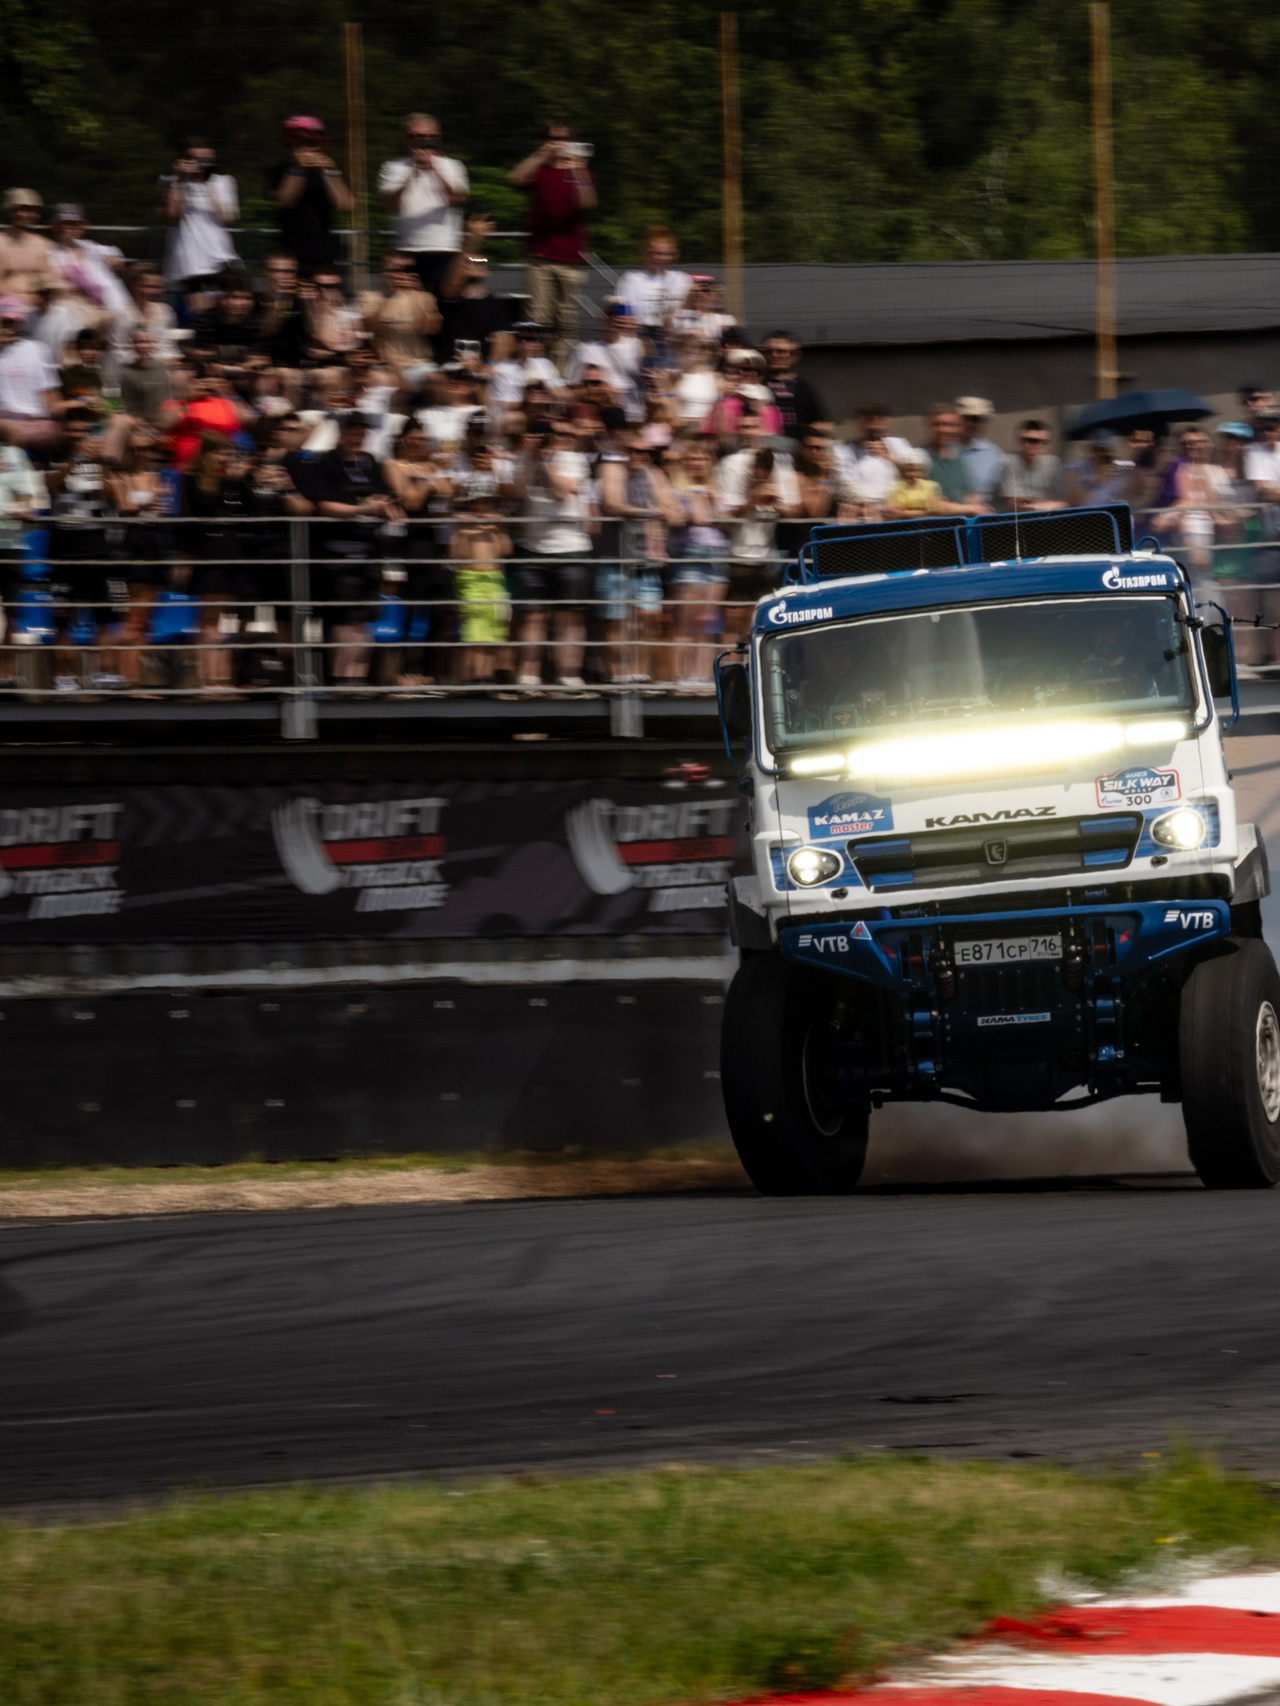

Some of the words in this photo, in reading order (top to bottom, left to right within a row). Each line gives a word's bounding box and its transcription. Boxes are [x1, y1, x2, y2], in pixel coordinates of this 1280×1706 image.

[1103, 778, 1138, 791] SILK
[1140, 775, 1171, 787] WAY
[1126, 795, 1152, 806] 300
[814, 809, 886, 826] KAMAZ
[925, 806, 1056, 828] KAMAZ
[830, 822, 874, 834] master
[1180, 912, 1214, 929] VTB
[813, 936, 849, 953] VTB
[1031, 938, 1057, 952] 716
